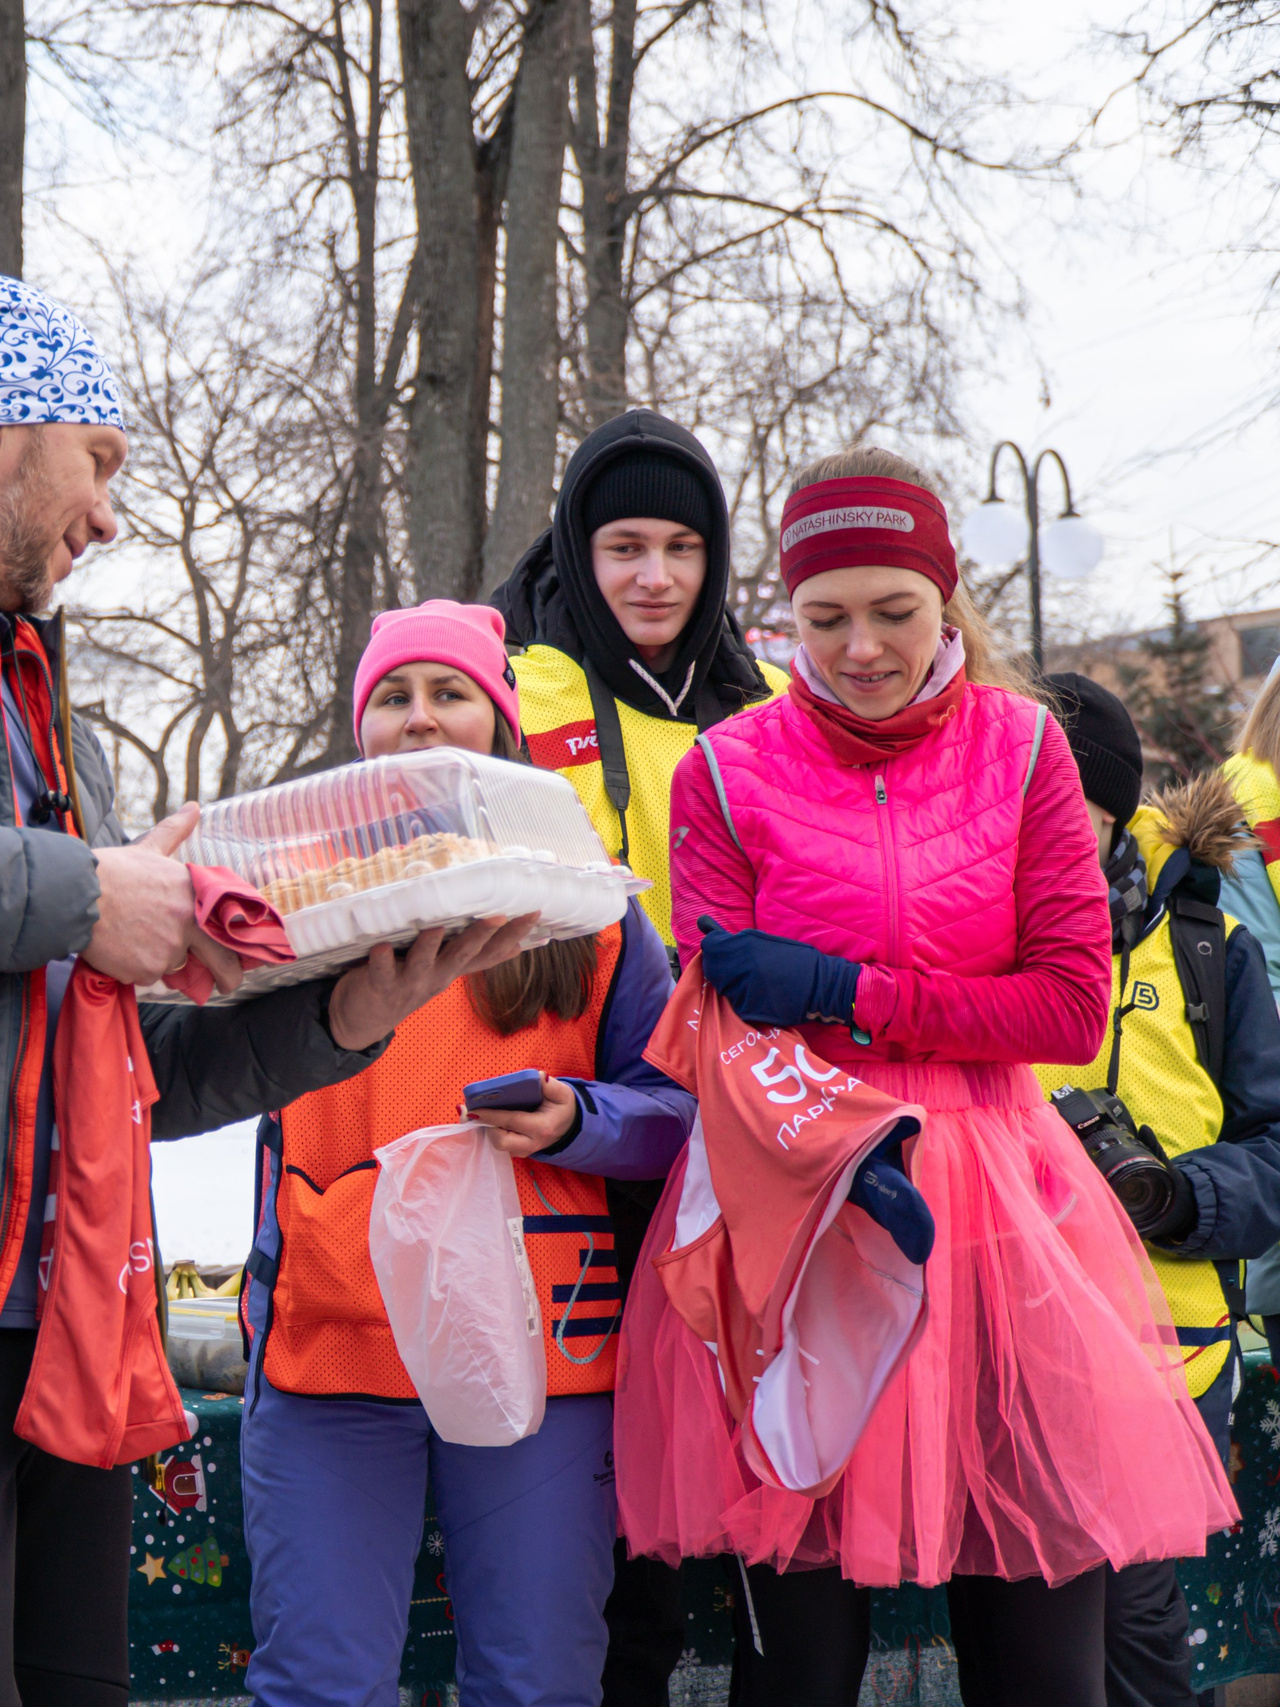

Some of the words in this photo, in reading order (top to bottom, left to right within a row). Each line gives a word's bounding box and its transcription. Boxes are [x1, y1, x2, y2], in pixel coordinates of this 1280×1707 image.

[791, 511, 873, 538] NATASHINSKY
[876, 511, 907, 527] PARK
[750, 1043, 841, 1104] 50
[1077, 1115, 1100, 1130] Canon
